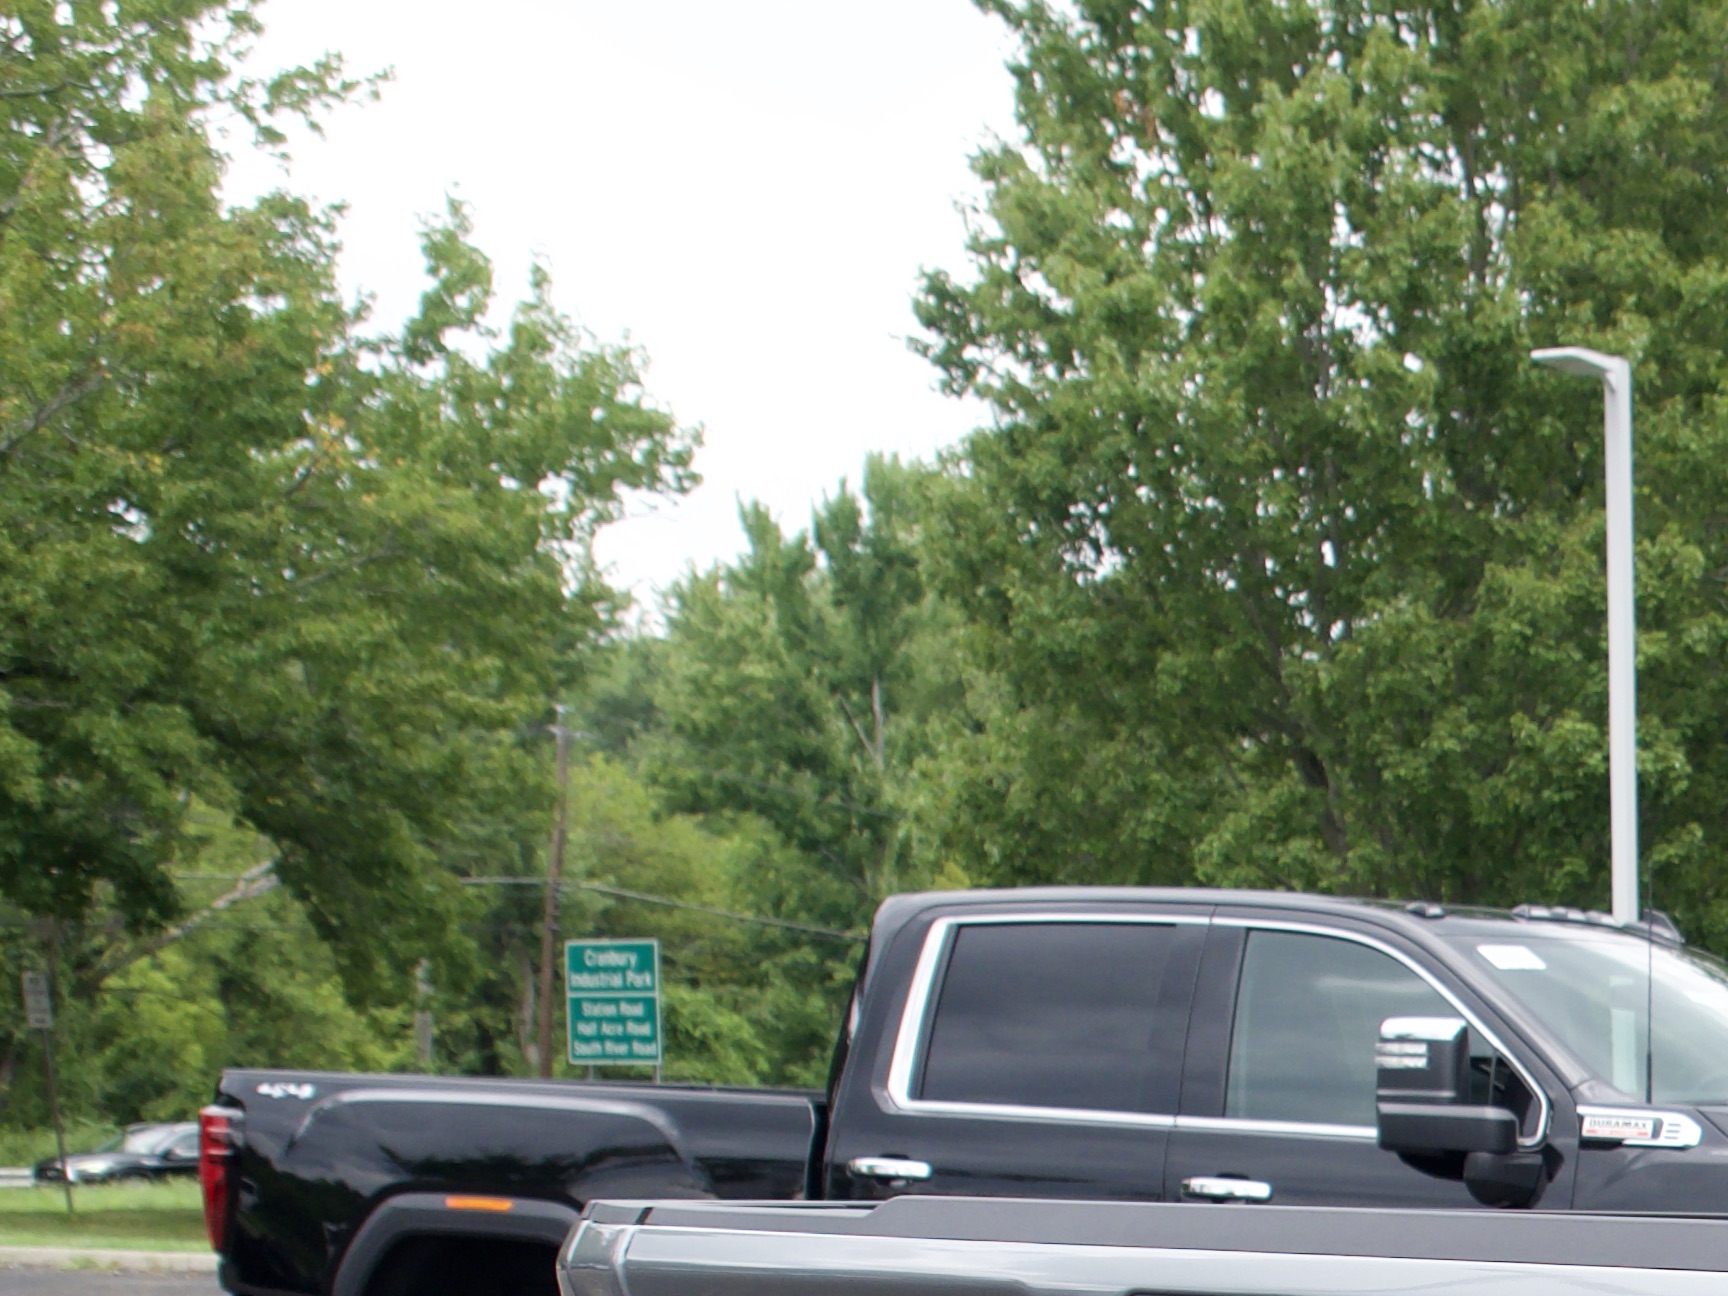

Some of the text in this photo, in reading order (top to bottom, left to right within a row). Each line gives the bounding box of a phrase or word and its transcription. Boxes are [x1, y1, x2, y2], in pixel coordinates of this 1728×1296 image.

[584, 949, 637, 968] Cranbury
[571, 971, 651, 987] Industrial Park
[581, 1001, 644, 1017] Station Road
[577, 1021, 651, 1036] Half Acre Road
[573, 1040, 657, 1055] South River Road
